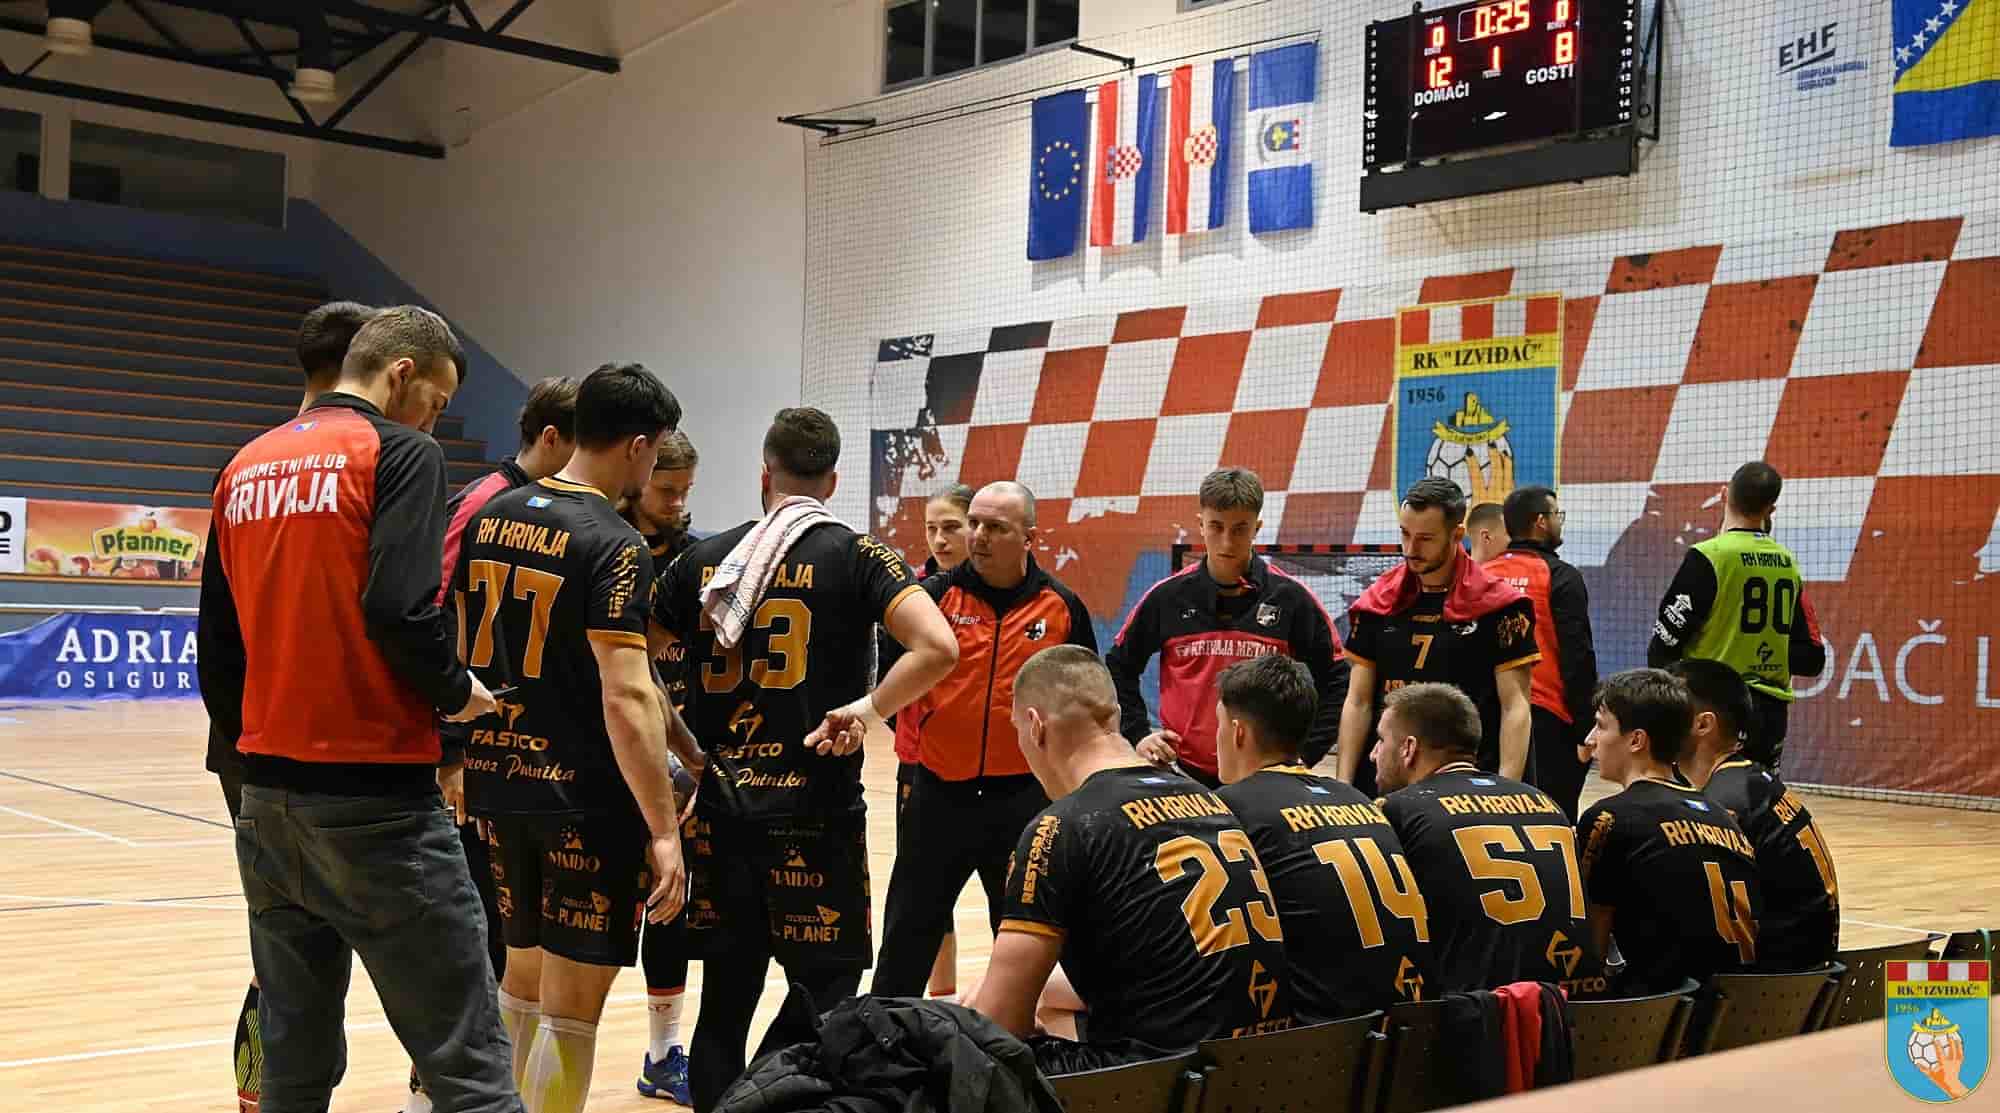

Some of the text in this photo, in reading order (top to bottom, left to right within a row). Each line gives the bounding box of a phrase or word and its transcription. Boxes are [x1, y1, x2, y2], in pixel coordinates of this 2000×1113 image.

[1431, 25, 1446, 48] 0
[1556, 31, 1573, 64] 8
[1779, 22, 1838, 68] EHF
[1429, 56, 1454, 88] 12
[1492, 45, 1502, 71] 1
[1525, 63, 1574, 85] GOSTI
[1413, 352, 1438, 370] RK
[1408, 386, 1447, 404] 1956
[304, 453, 347, 469] KLUB
[469, 559, 565, 678] 77
[1740, 576, 1794, 634] 80
[56, 627, 198, 665] ADRIA
[1411, 633, 1435, 670] 7
[56, 671, 192, 689] OSIGUR
[471, 729, 550, 751] FASTCO
[1451, 824, 1587, 926] 57
[1154, 829, 1284, 959] 23
[1311, 838, 1431, 949] 14
[1703, 861, 1761, 964] 4
[783, 926, 841, 943] PLANET
